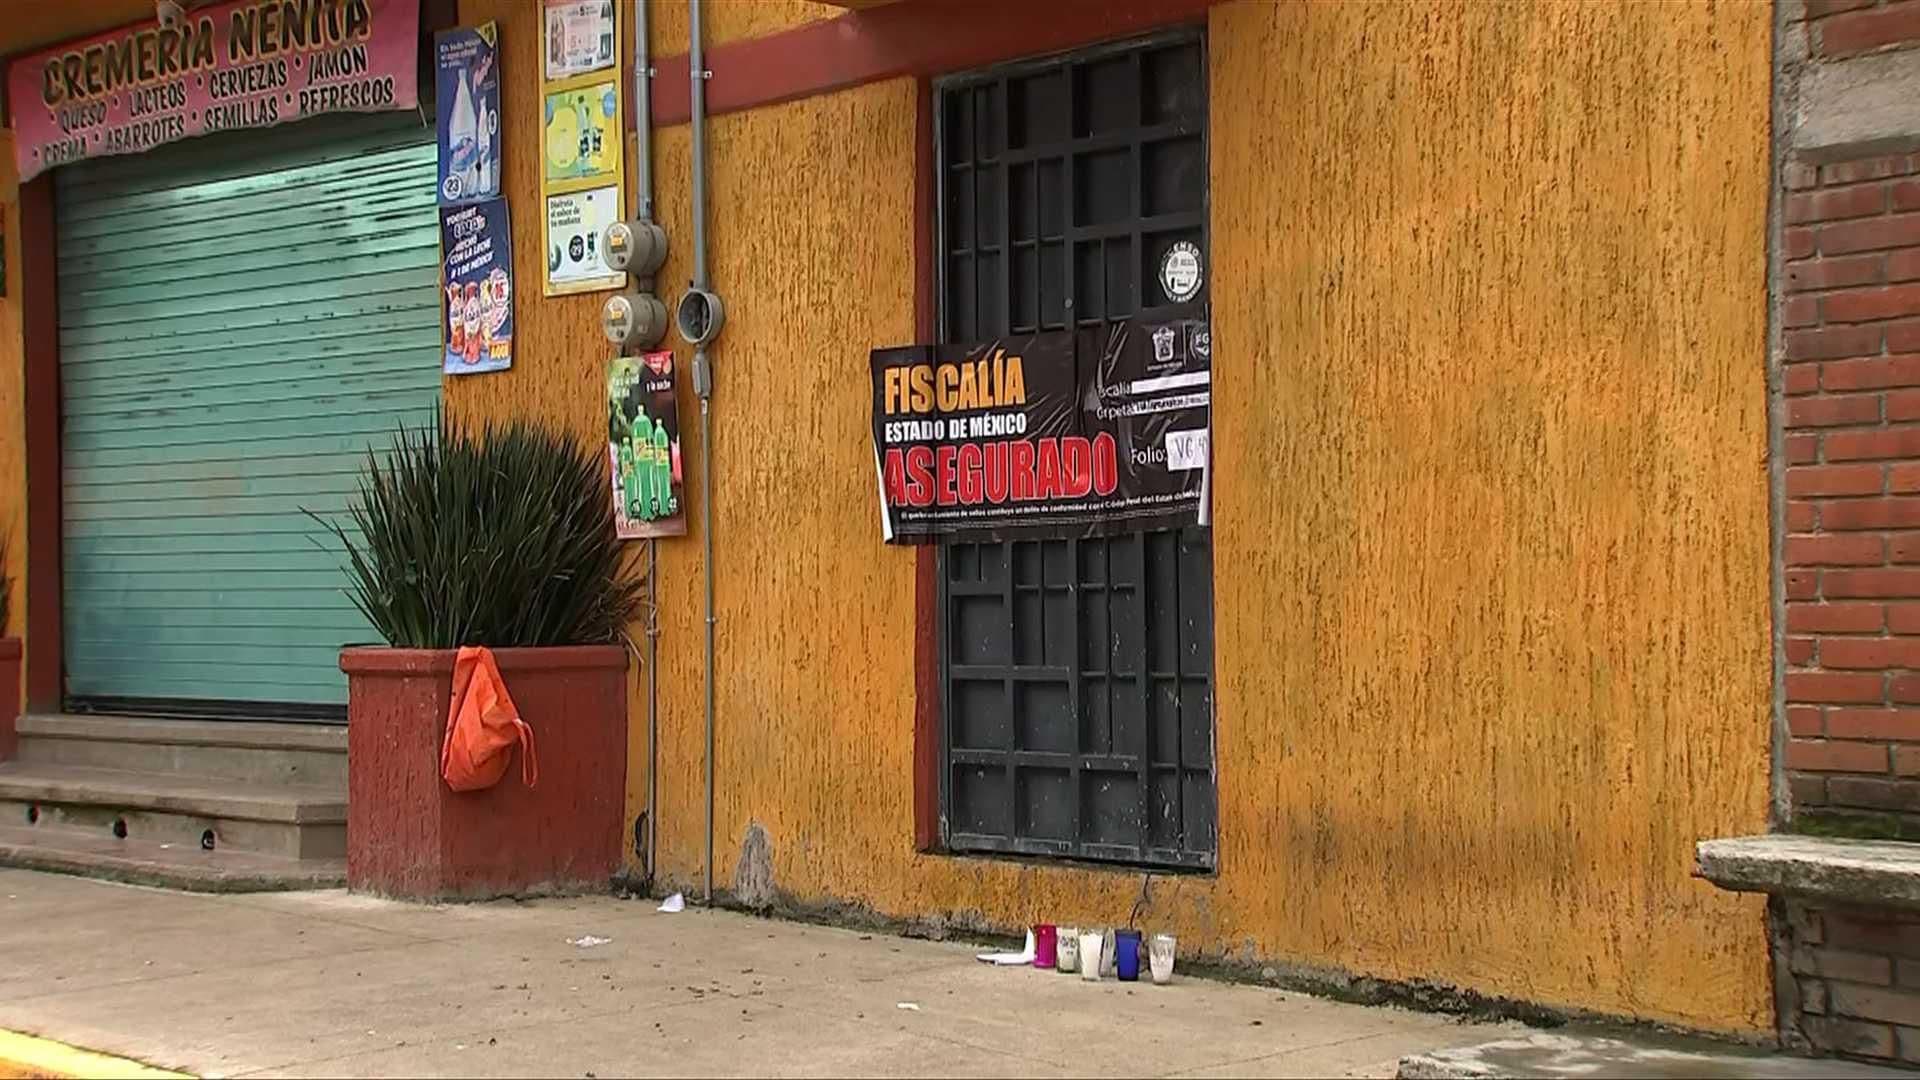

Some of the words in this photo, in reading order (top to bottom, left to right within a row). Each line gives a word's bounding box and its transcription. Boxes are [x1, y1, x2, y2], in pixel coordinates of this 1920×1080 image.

[229, 0, 371, 62] NENITA
[62, 102, 107, 134] QUESO
[129, 81, 187, 117] LACTEOS
[209, 60, 287, 100] CERVEZAS
[308, 45, 368, 86] JAMON
[44, 136, 88, 166] CREMA
[106, 115, 185, 151] ABARROTES
[203, 97, 279, 131] SEMILLAS
[299, 77, 394, 115] REFRESCOS
[447, 178, 460, 195] 23
[884, 350, 1027, 415] FISCALÍA
[885, 418, 945, 443] ESTADO
[949, 418, 969, 439] DE
[969, 411, 1028, 438] MÉXICO
[1131, 446, 1168, 465] Folio:
[883, 431, 1118, 507] ASEGURADO
